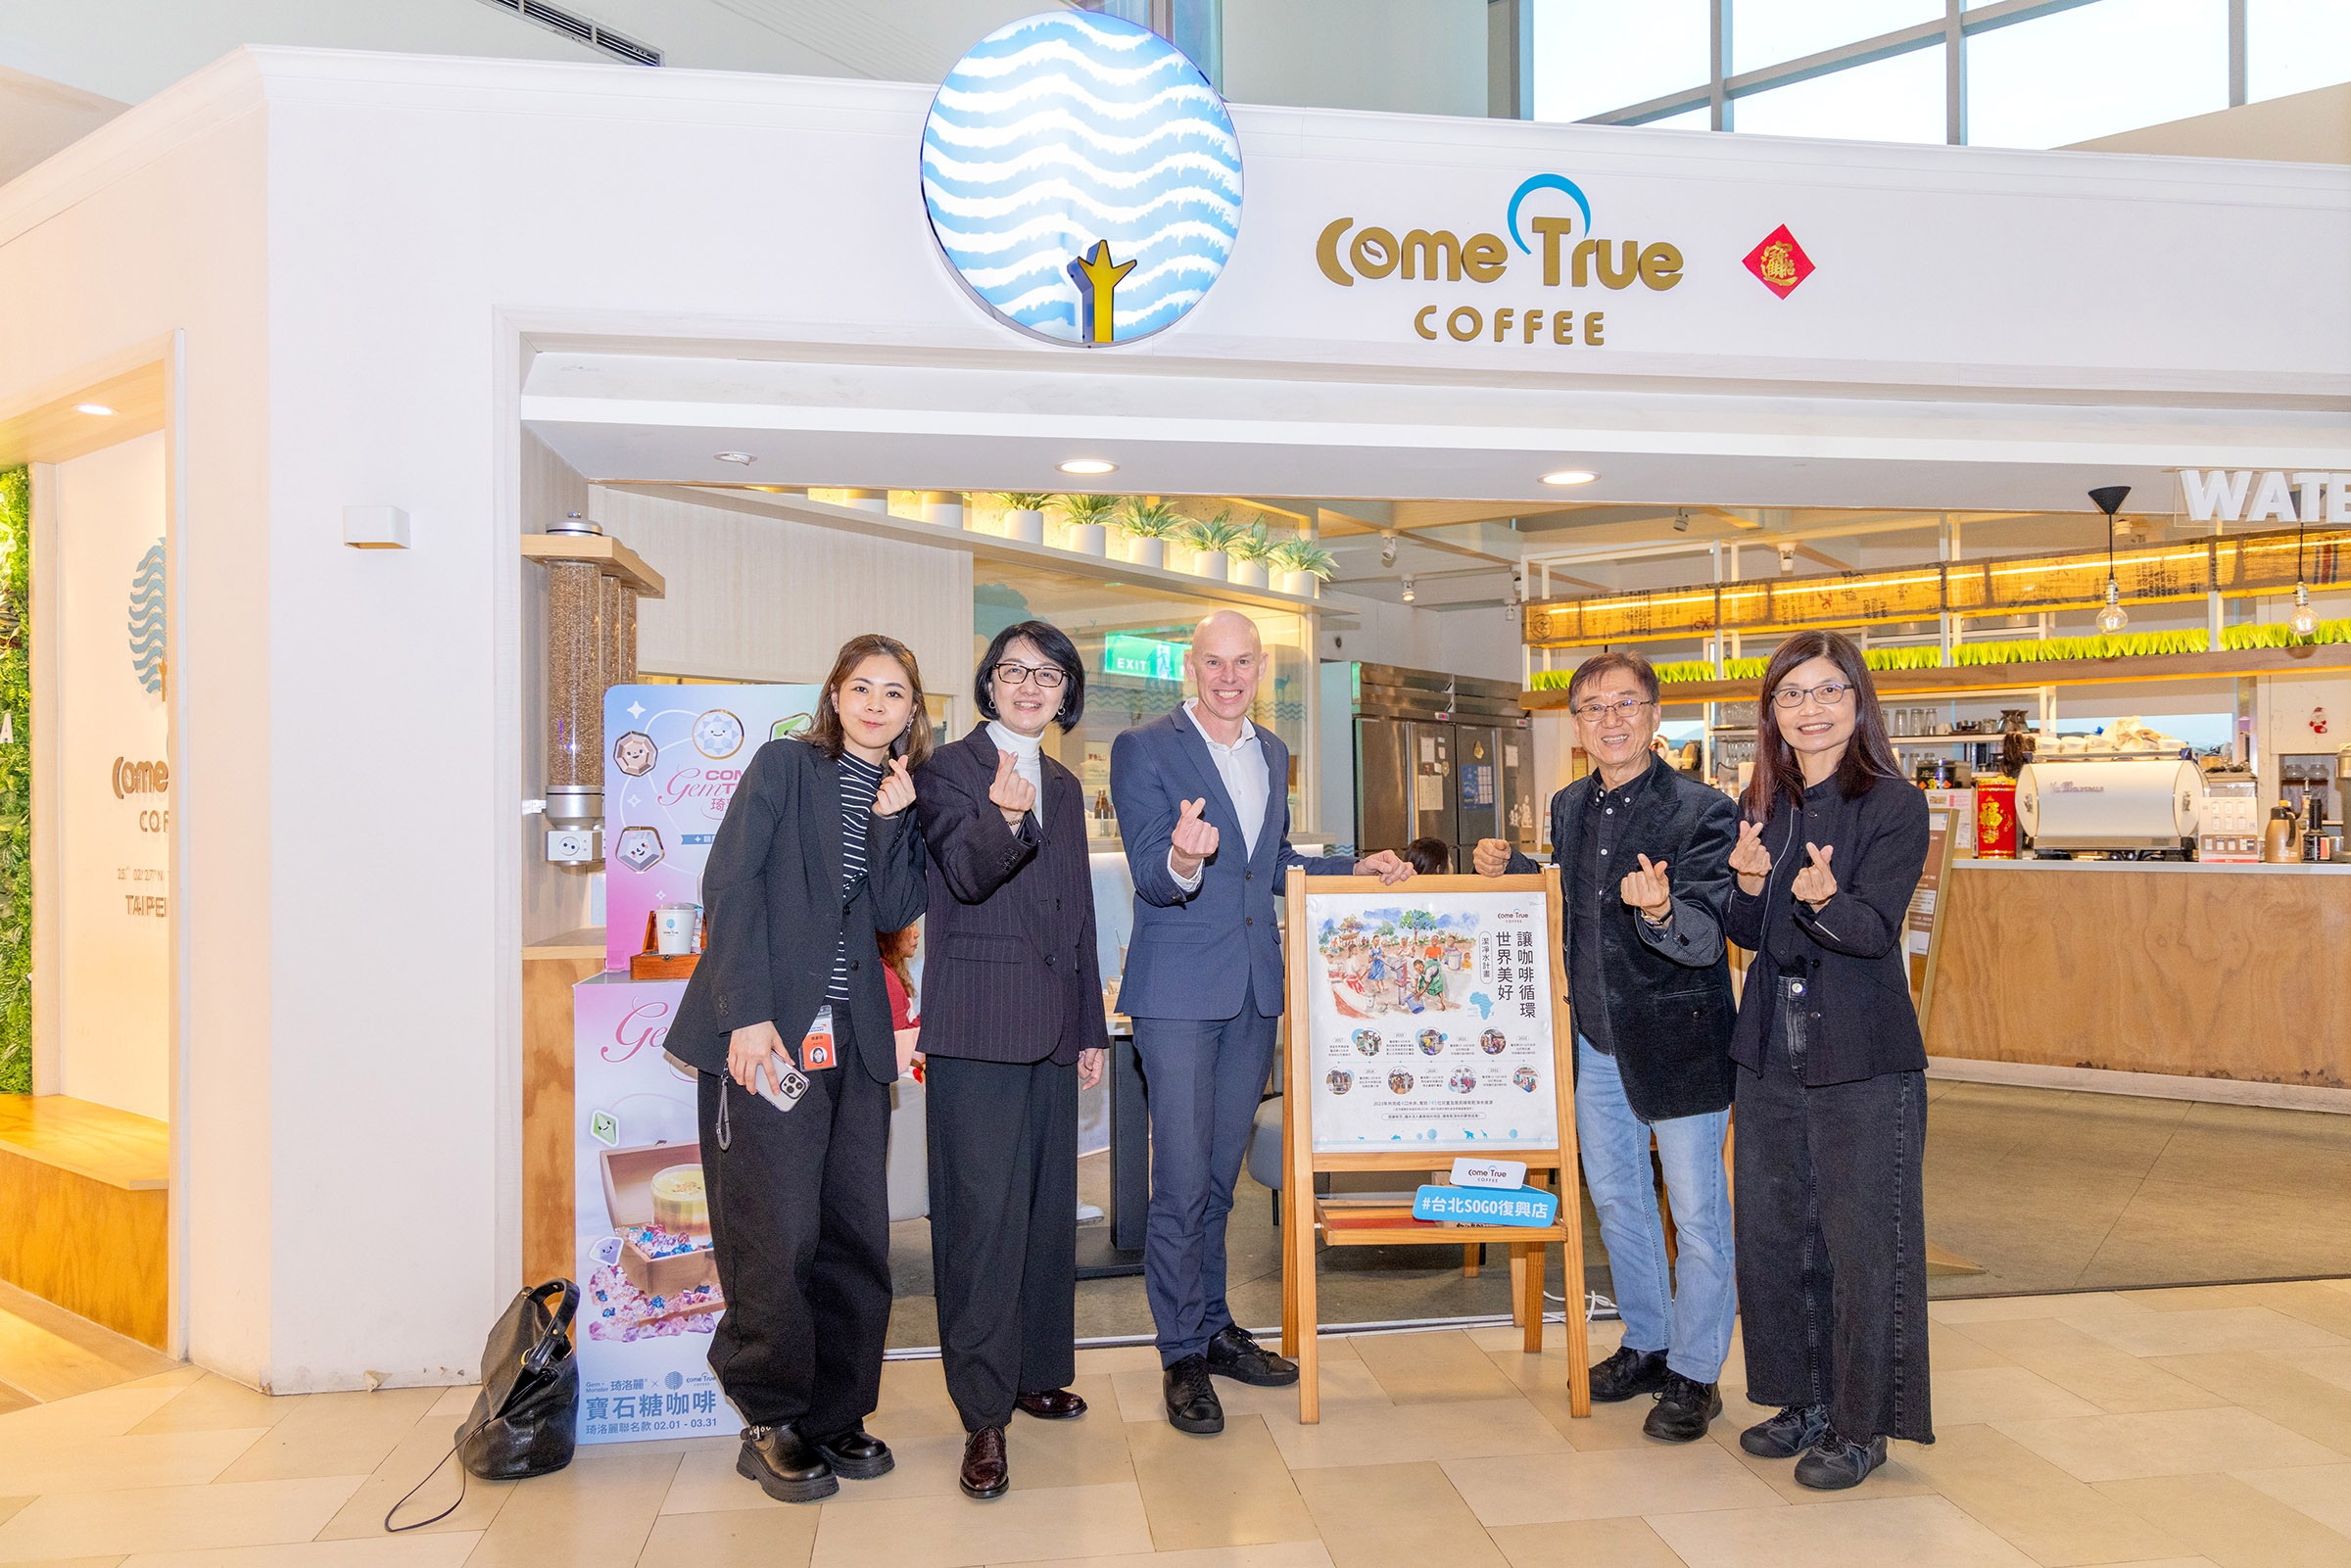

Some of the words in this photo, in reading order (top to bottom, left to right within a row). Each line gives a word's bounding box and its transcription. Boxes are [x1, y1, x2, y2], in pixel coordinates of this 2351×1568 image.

[1317, 217, 1508, 286] Come
[1532, 216, 1683, 291] True
[1414, 305, 1605, 346] COFFEE
[1117, 657, 1147, 672] EXIT
[112, 756, 168, 799] Come
[657, 763, 723, 806] Gem
[125, 894, 167, 918] TAIPEI
[1496, 931, 1514, 1001] 世界美好
[1516, 930, 1536, 1019] 讓咖啡循環
[1490, 1168, 1507, 1178] True
[1421, 1196, 1549, 1219] #台北SOGO復興店
[586, 1390, 716, 1421] 寶石糖咖啡
[653, 1420, 680, 1431] 02.01
[691, 1417, 717, 1428] 03.31
